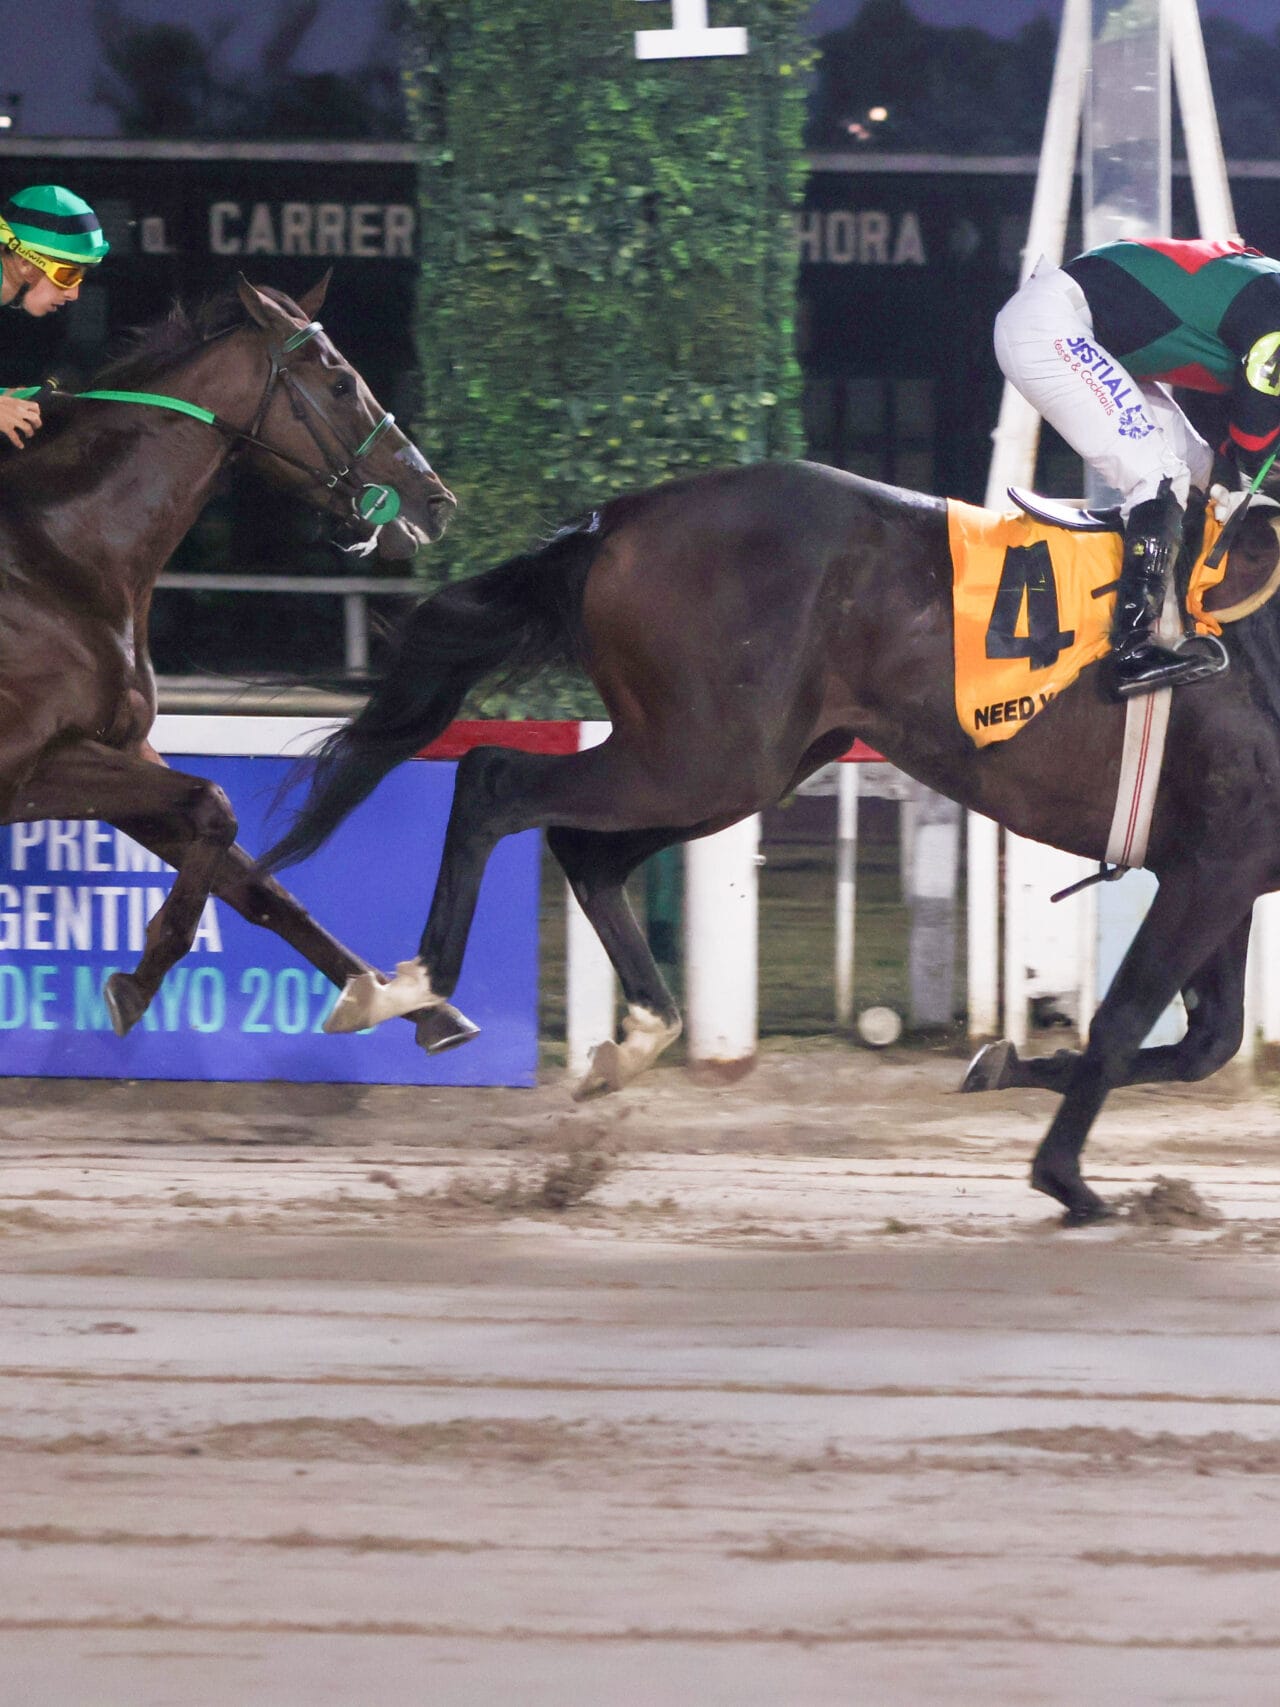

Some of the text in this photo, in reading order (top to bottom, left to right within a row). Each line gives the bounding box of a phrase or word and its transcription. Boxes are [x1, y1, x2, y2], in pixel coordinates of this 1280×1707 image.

[793, 210, 927, 265] HORA
[1070, 362, 1081, 372] &
[1081, 369, 1114, 416] Cocktails
[985, 540, 1075, 672] 4
[974, 695, 1035, 730] NEED
[0, 965, 59, 1030] DE
[241, 967, 378, 1035] 202
